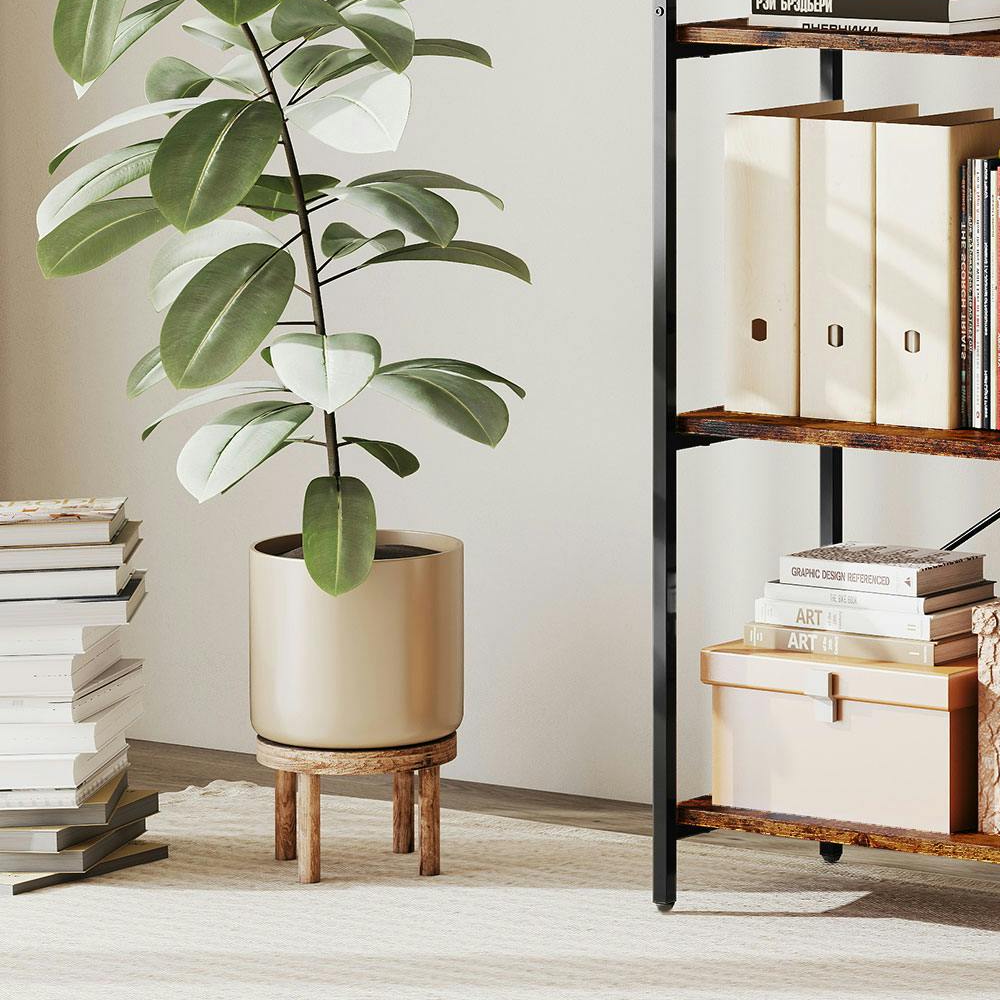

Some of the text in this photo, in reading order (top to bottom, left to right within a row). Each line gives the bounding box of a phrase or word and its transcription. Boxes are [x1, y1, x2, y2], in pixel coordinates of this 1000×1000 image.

[791, 566, 891, 586] GRAPHIC DESIGN REFERENCED
[796, 607, 823, 626] ART
[787, 631, 818, 651] ART
